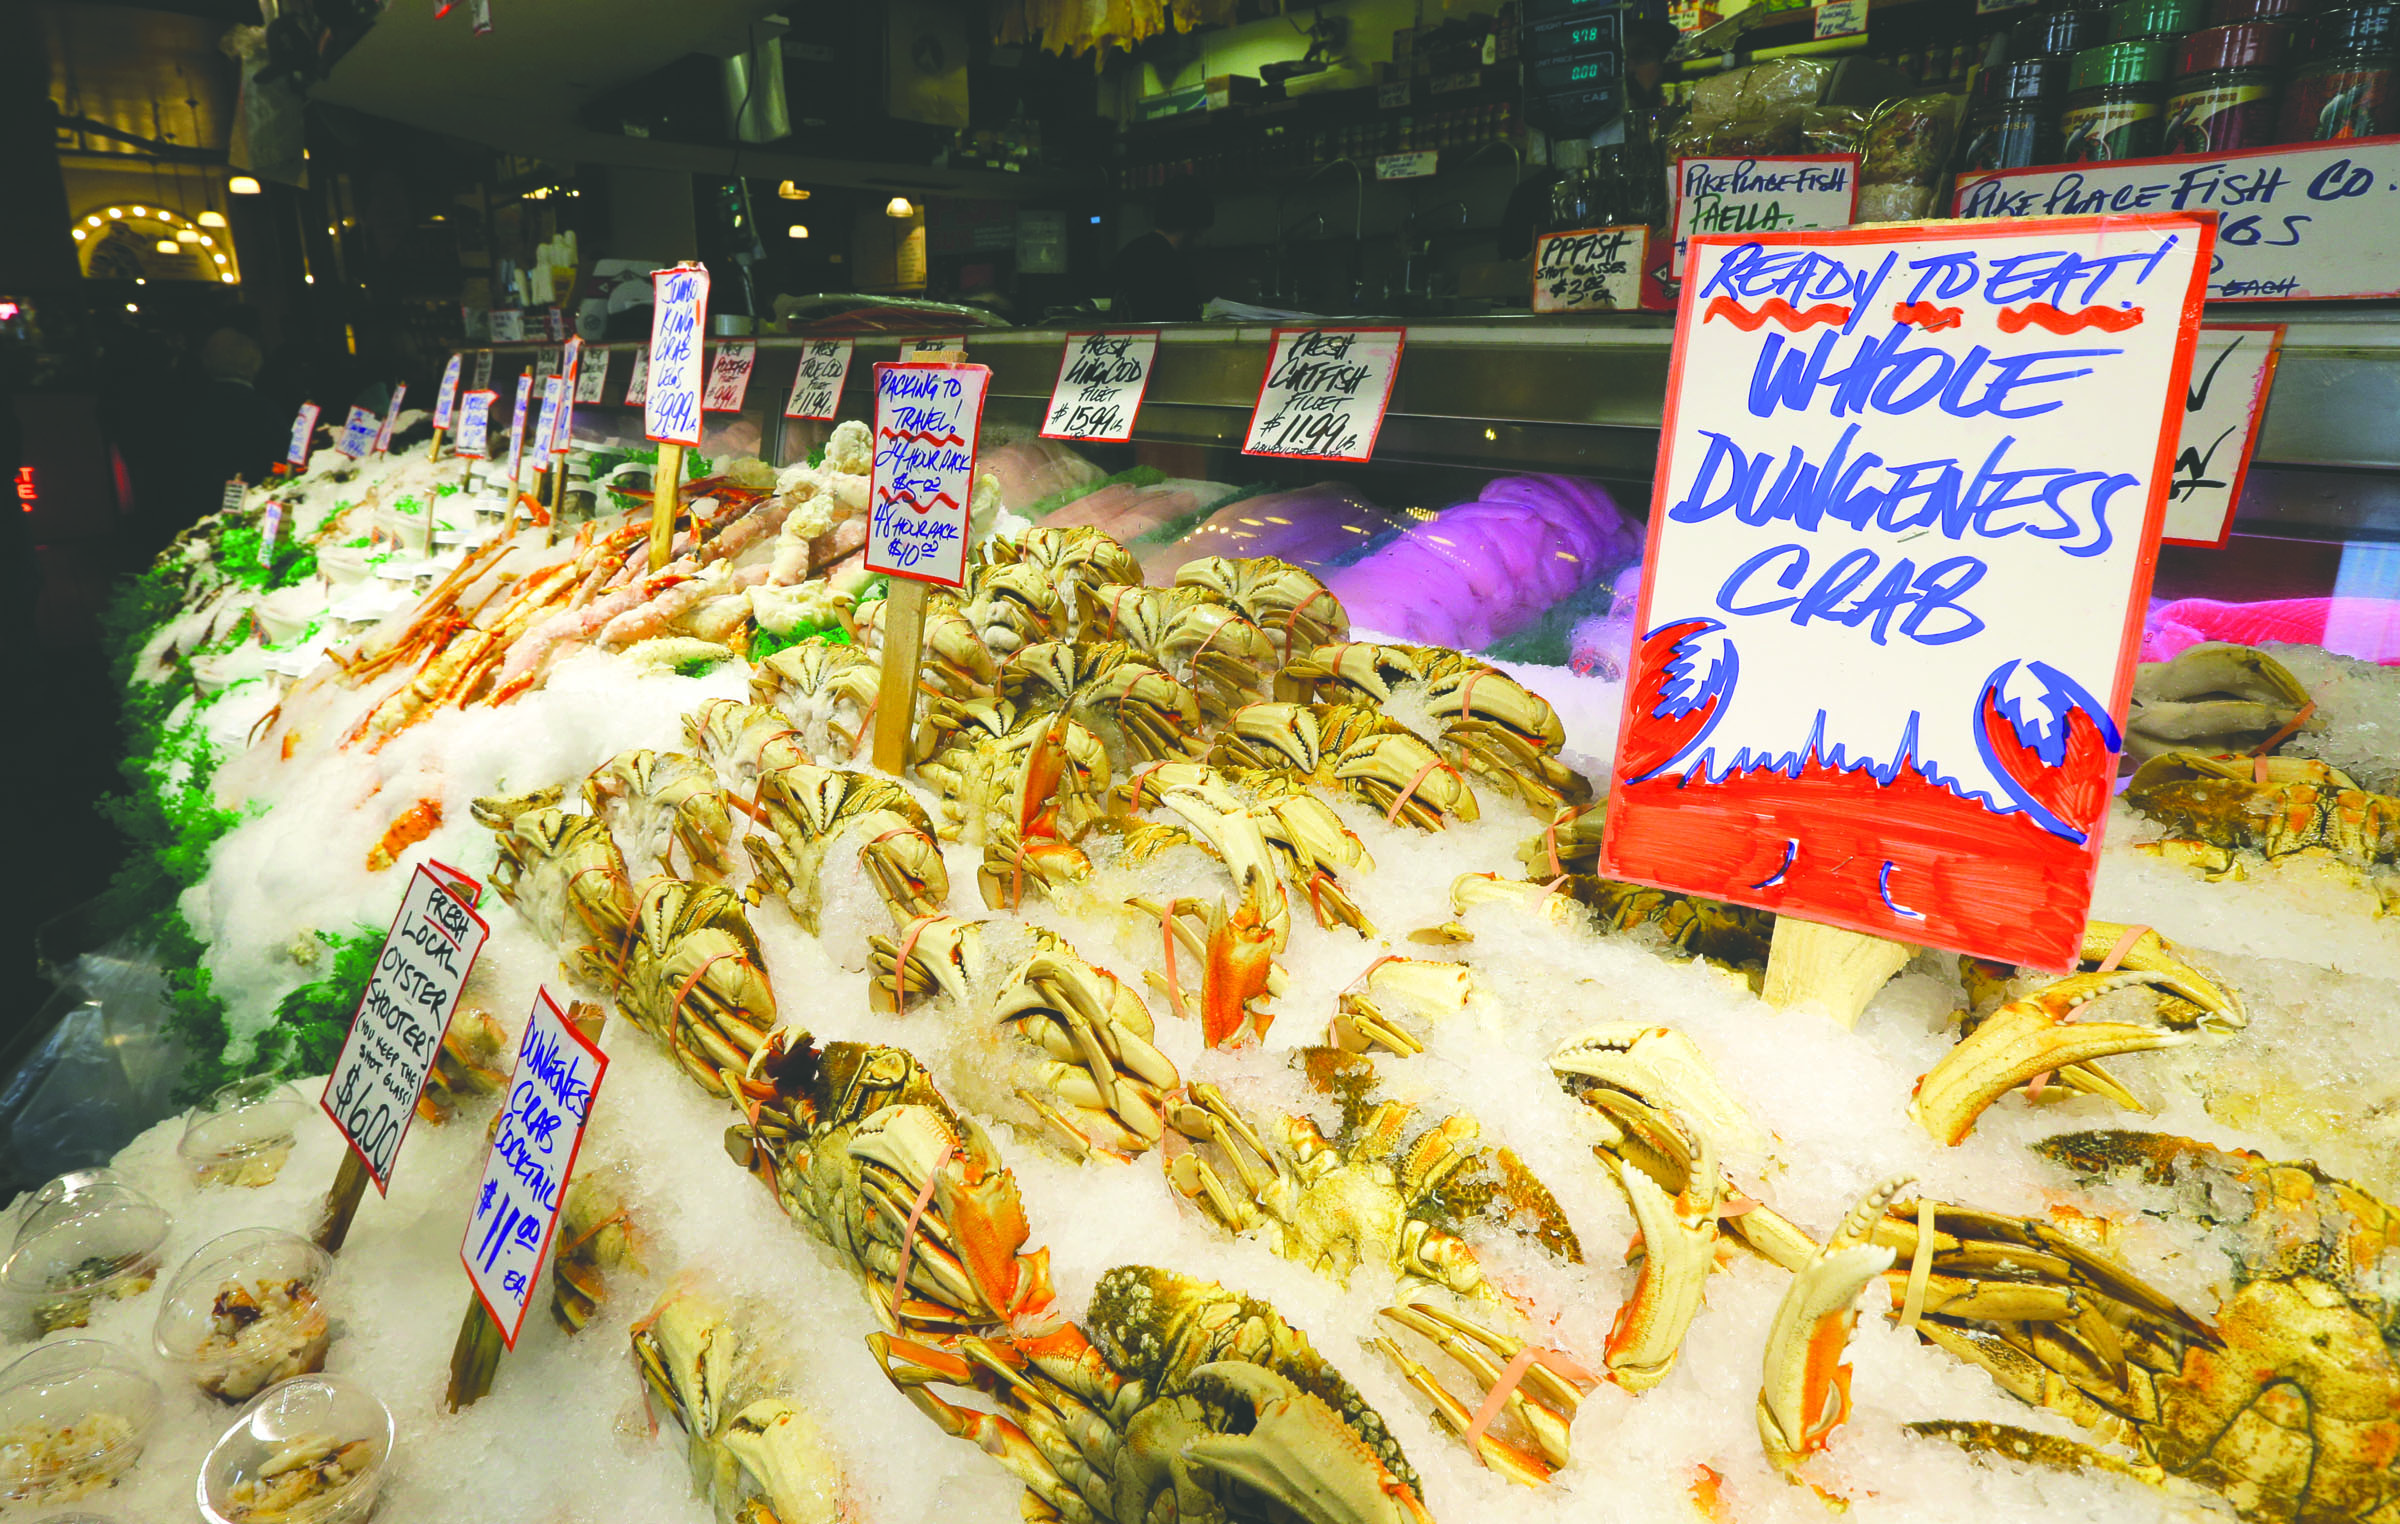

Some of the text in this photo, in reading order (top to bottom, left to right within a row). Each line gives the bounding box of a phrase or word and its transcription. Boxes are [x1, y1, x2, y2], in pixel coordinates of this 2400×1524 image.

[1686, 164, 1733, 197] PIKE
[1962, 181, 2044, 218] PIKE
[2042, 173, 2171, 215] PLACE
[2170, 163, 2292, 211] FISH
[1535, 266, 1570, 280] SHOT
[1700, 235, 2179, 336] READY TO EAT!
[660, 305, 694, 337] KING
[1080, 334, 1133, 358] FRESH
[1288, 329, 1356, 361] FRESH
[655, 335, 692, 364] CRAB
[1268, 357, 1373, 395] CATFISH
[1748, 323, 2125, 419] WHOLE
[878, 369, 962, 402] PACKING TO
[875, 435, 972, 475] 24 HOUR PACK
[1669, 424, 2141, 558] DUNGENESS
[874, 496, 959, 550] 48 HOUR PACK
[1716, 543, 1988, 646] CRAB
[426, 888, 470, 944] FRESH
[401, 911, 459, 979] LOCAL
[382, 946, 448, 1031] OYSTER
[366, 978, 436, 1071] SHOOTERS
[359, 1044, 385, 1076] SHOT
[376, 1034, 400, 1069] KEEP
[400, 1063, 417, 1089] THE
[519, 1014, 593, 1128] DUNGENESS
[511, 1080, 562, 1154] CRAB
[494, 1113, 557, 1212] COCKTAIL
